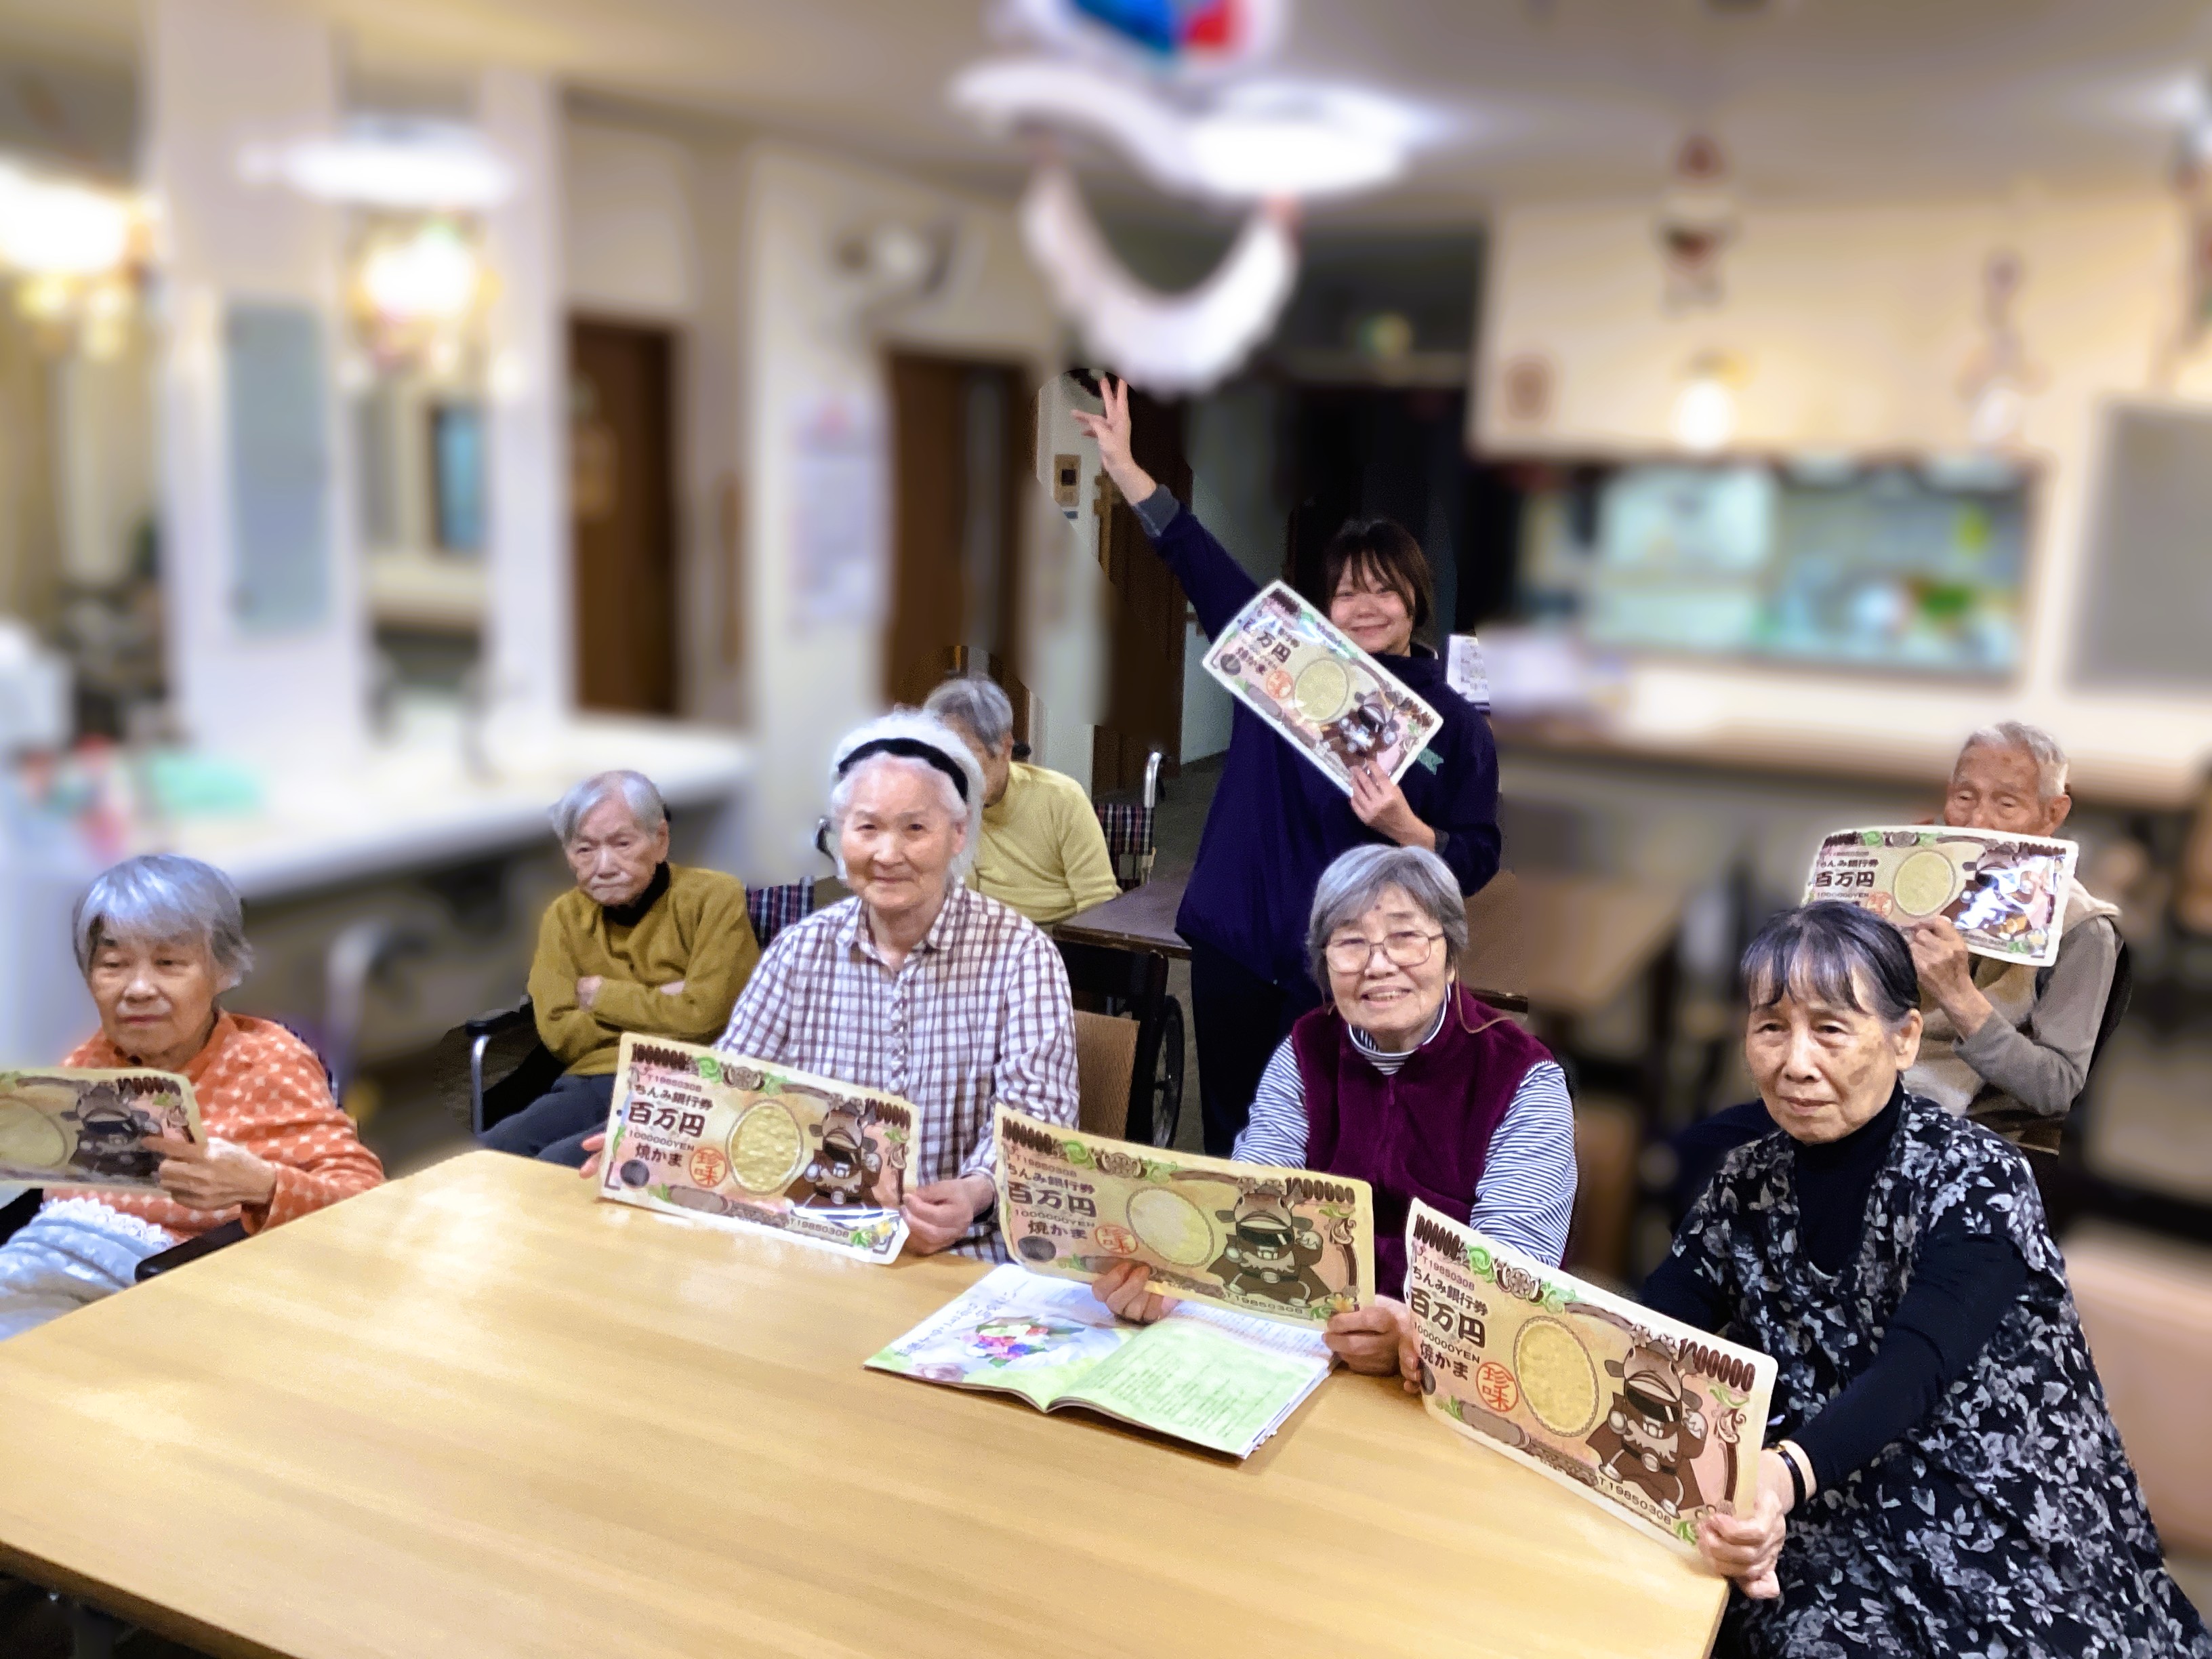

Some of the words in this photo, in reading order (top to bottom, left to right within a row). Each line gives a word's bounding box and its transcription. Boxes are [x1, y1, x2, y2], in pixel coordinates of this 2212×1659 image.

[1816, 871, 1875, 888] 百万円
[629, 1101, 705, 1138] 百万円
[1008, 1181, 1097, 1218] 百万円
[1411, 1288, 1486, 1349] 百万円
[1414, 1322, 1480, 1364] 1000000YEN
